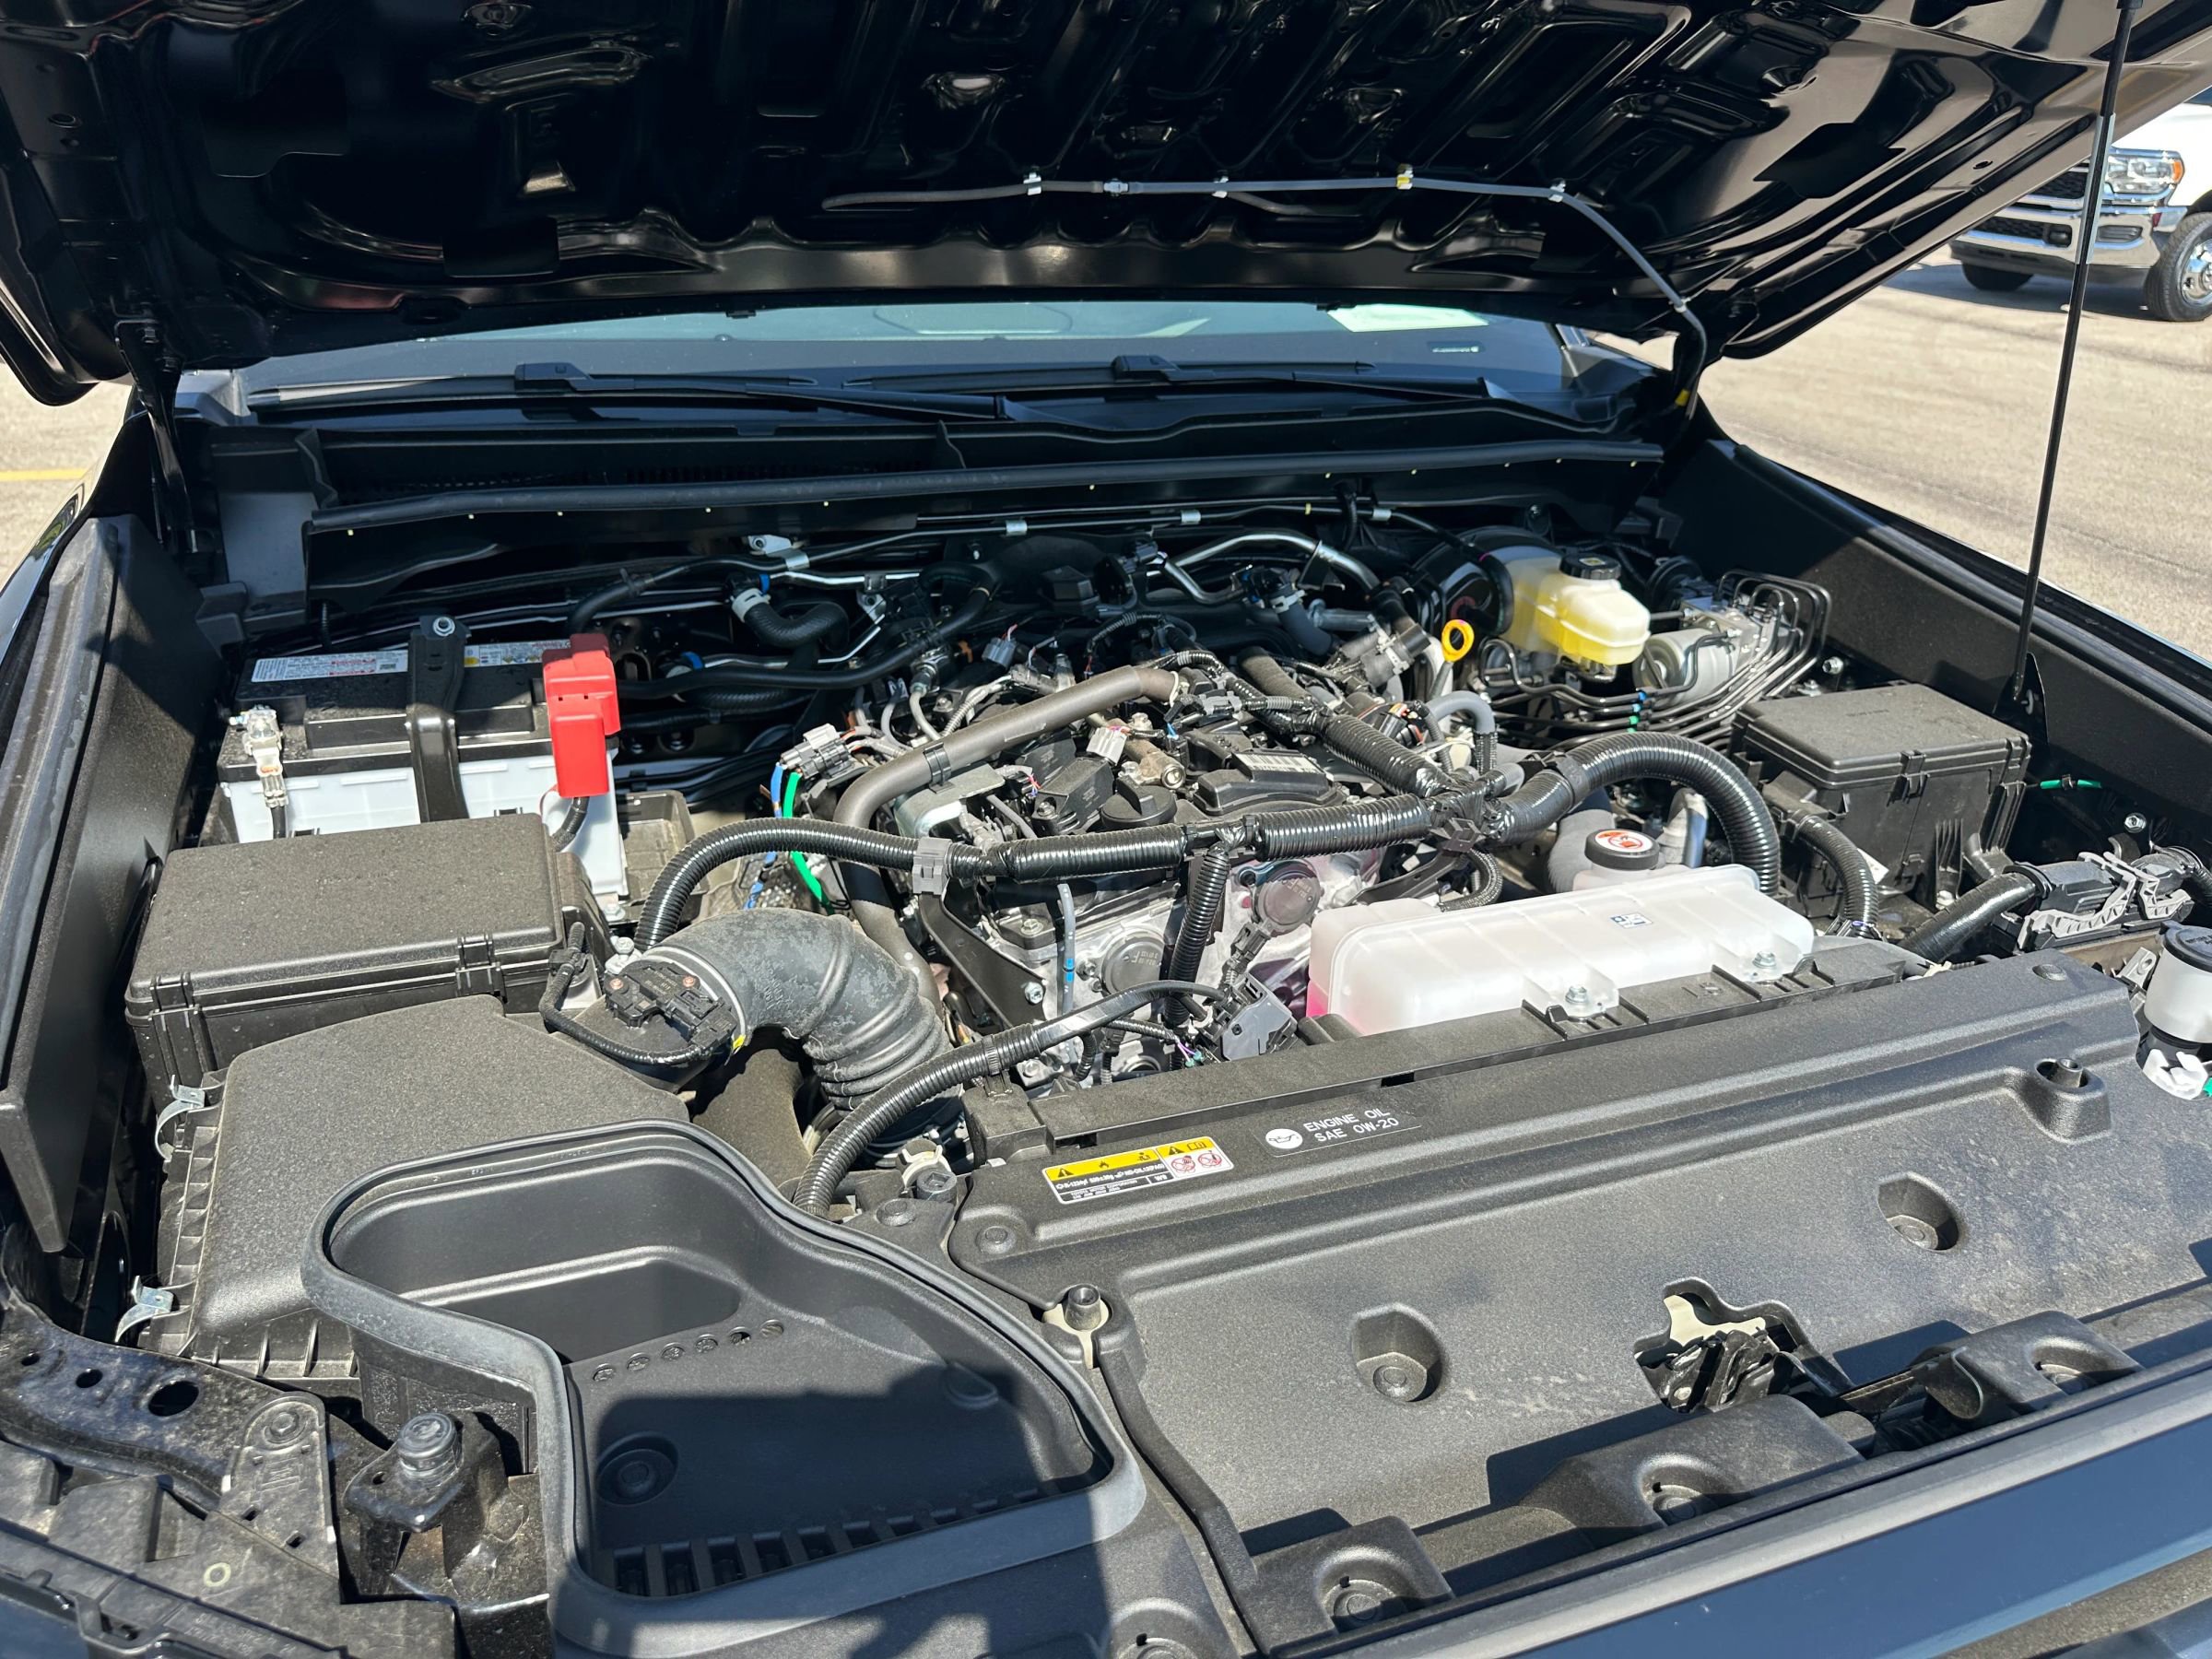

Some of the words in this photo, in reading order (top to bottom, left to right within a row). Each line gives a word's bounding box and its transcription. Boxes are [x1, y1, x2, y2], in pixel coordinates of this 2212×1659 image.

[1303, 1113, 1359, 1132] ENGINE
[1364, 1108, 1391, 1119] OIL
[1313, 1128, 1347, 1142] SAE
[1352, 1118, 1399, 1134] 0W-20
